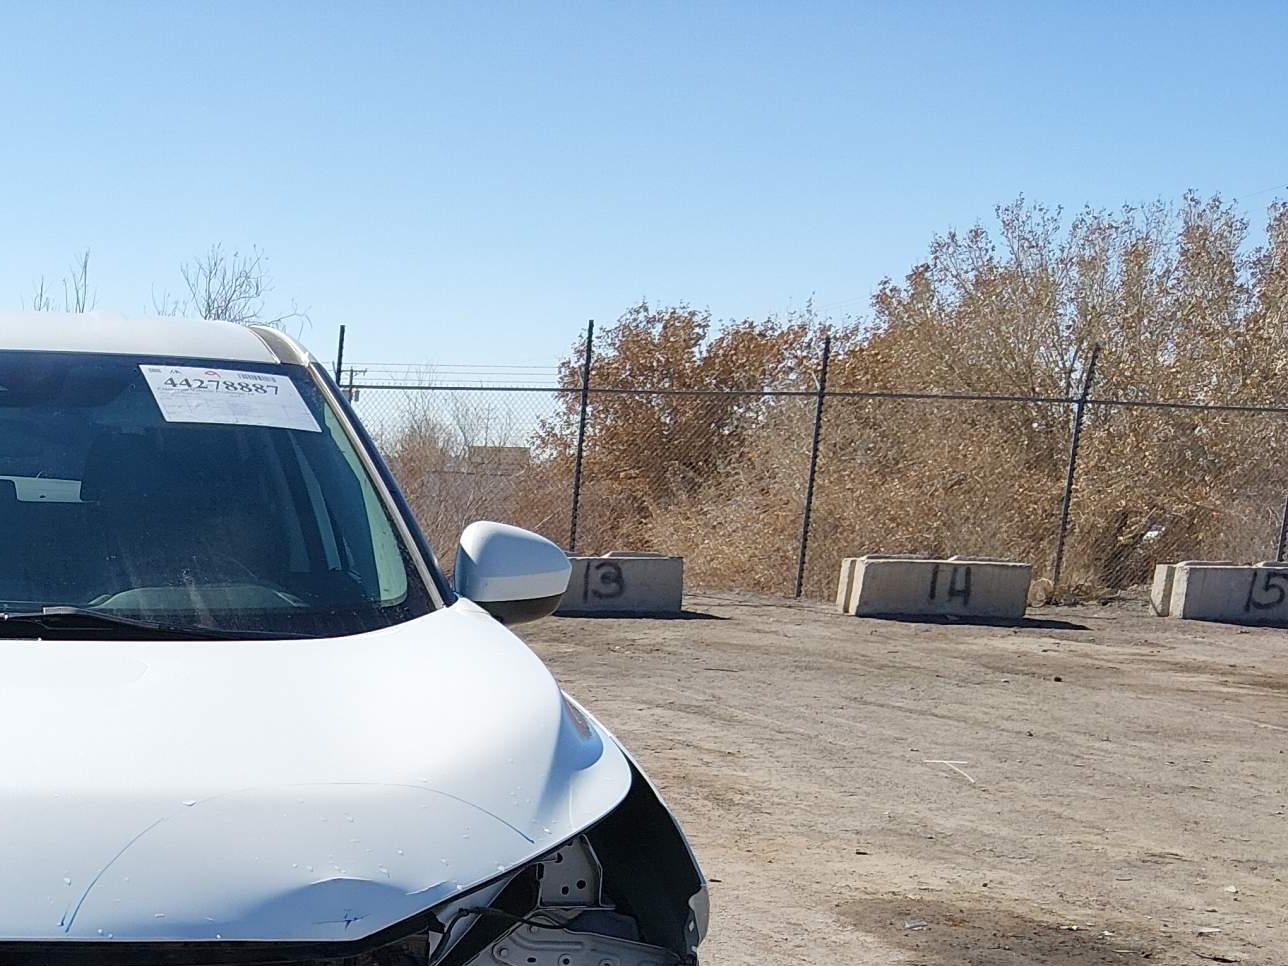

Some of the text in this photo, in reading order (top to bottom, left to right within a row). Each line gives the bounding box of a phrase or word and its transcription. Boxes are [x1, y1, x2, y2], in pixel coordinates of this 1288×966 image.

[163, 377, 279, 396] 44278887
[583, 560, 625, 604] 13
[928, 564, 972, 607] 14
[1244, 570, 1288, 612] 15
